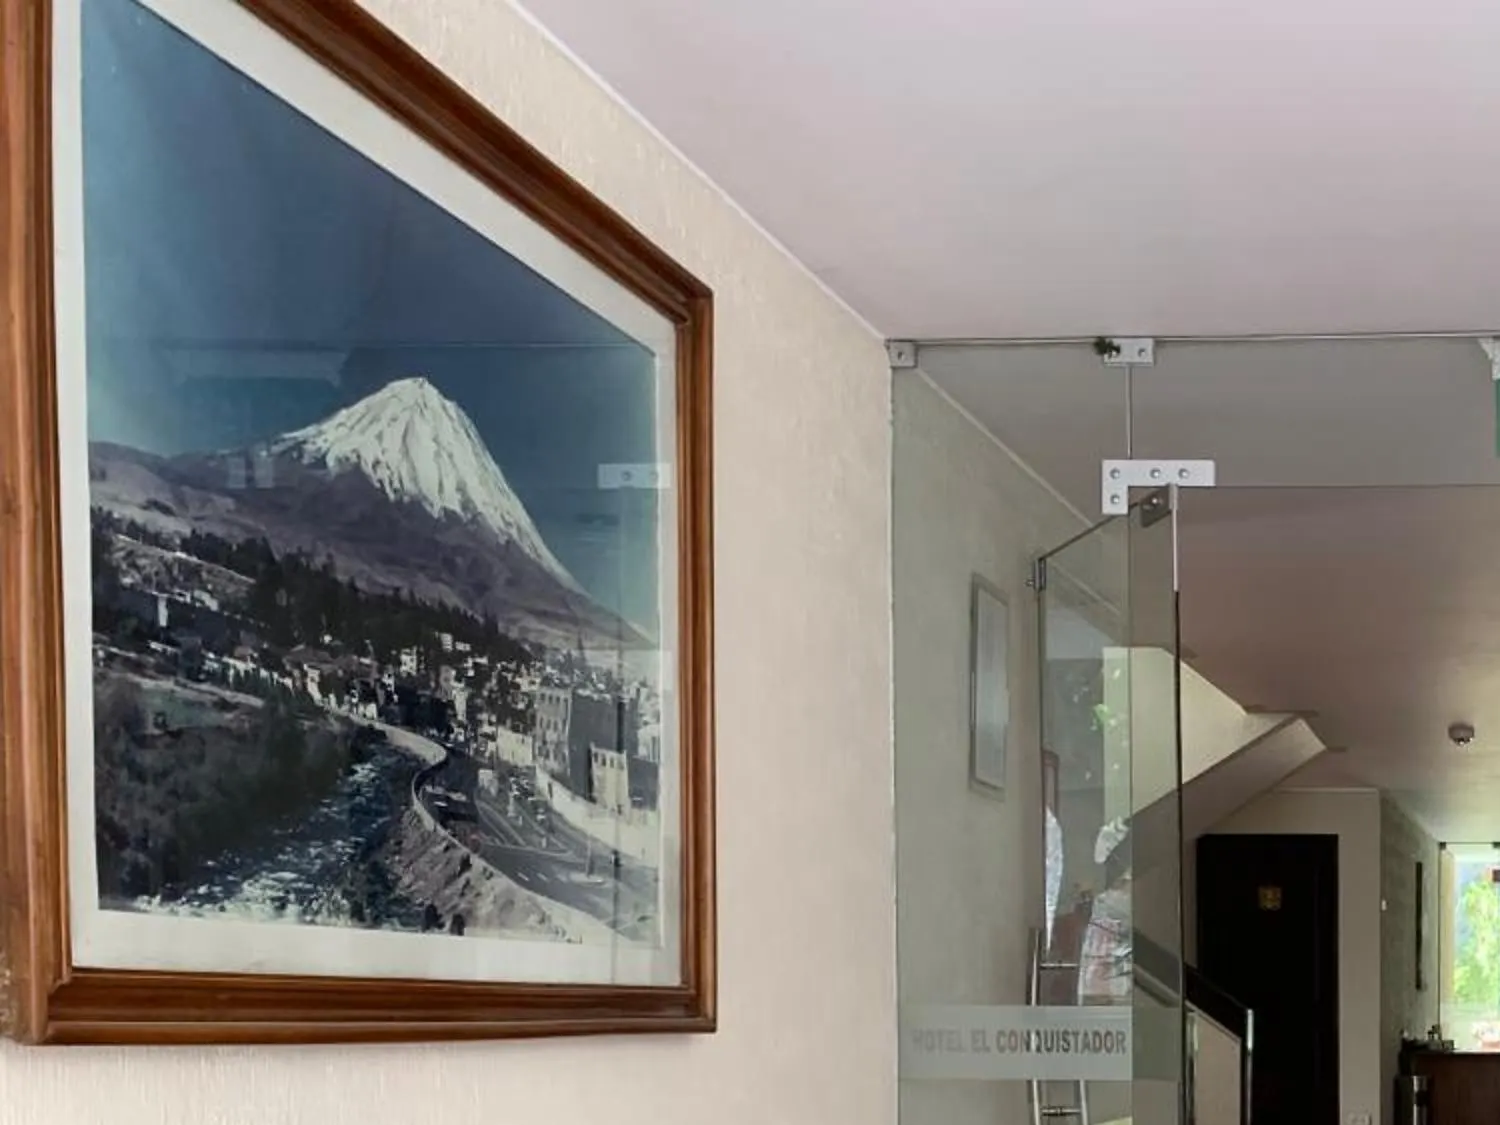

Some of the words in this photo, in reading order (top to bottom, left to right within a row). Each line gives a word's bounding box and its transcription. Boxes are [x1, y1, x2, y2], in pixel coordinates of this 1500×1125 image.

[911, 1029, 963, 1053] HOTEL
[970, 1029, 991, 1053] EL
[996, 1029, 1127, 1054] CONQUISTADOR
